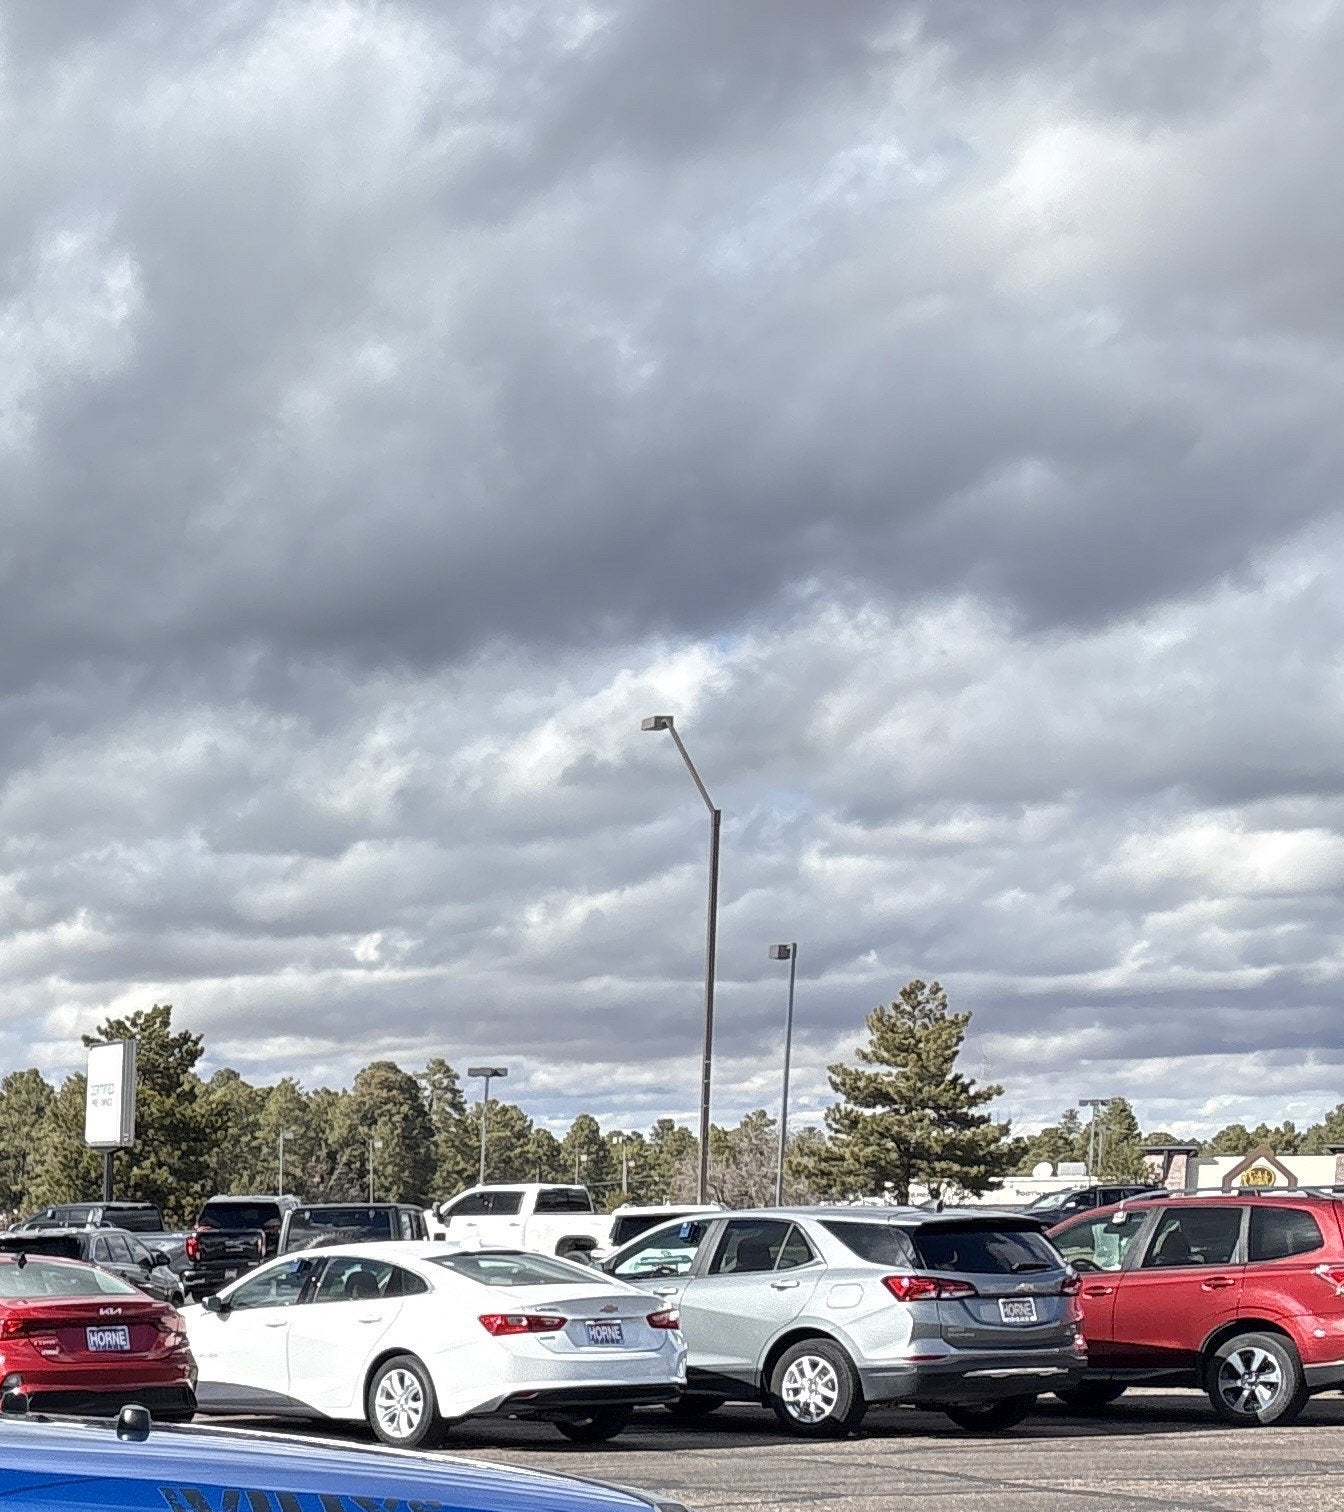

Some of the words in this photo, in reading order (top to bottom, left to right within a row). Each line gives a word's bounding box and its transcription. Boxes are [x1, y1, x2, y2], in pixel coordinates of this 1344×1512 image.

[99, 1307, 122, 1316] KIA
[1003, 1303, 1032, 1317] HORNE
[89, 1330, 127, 1346] HORNE
[589, 1325, 622, 1341] HORNE
